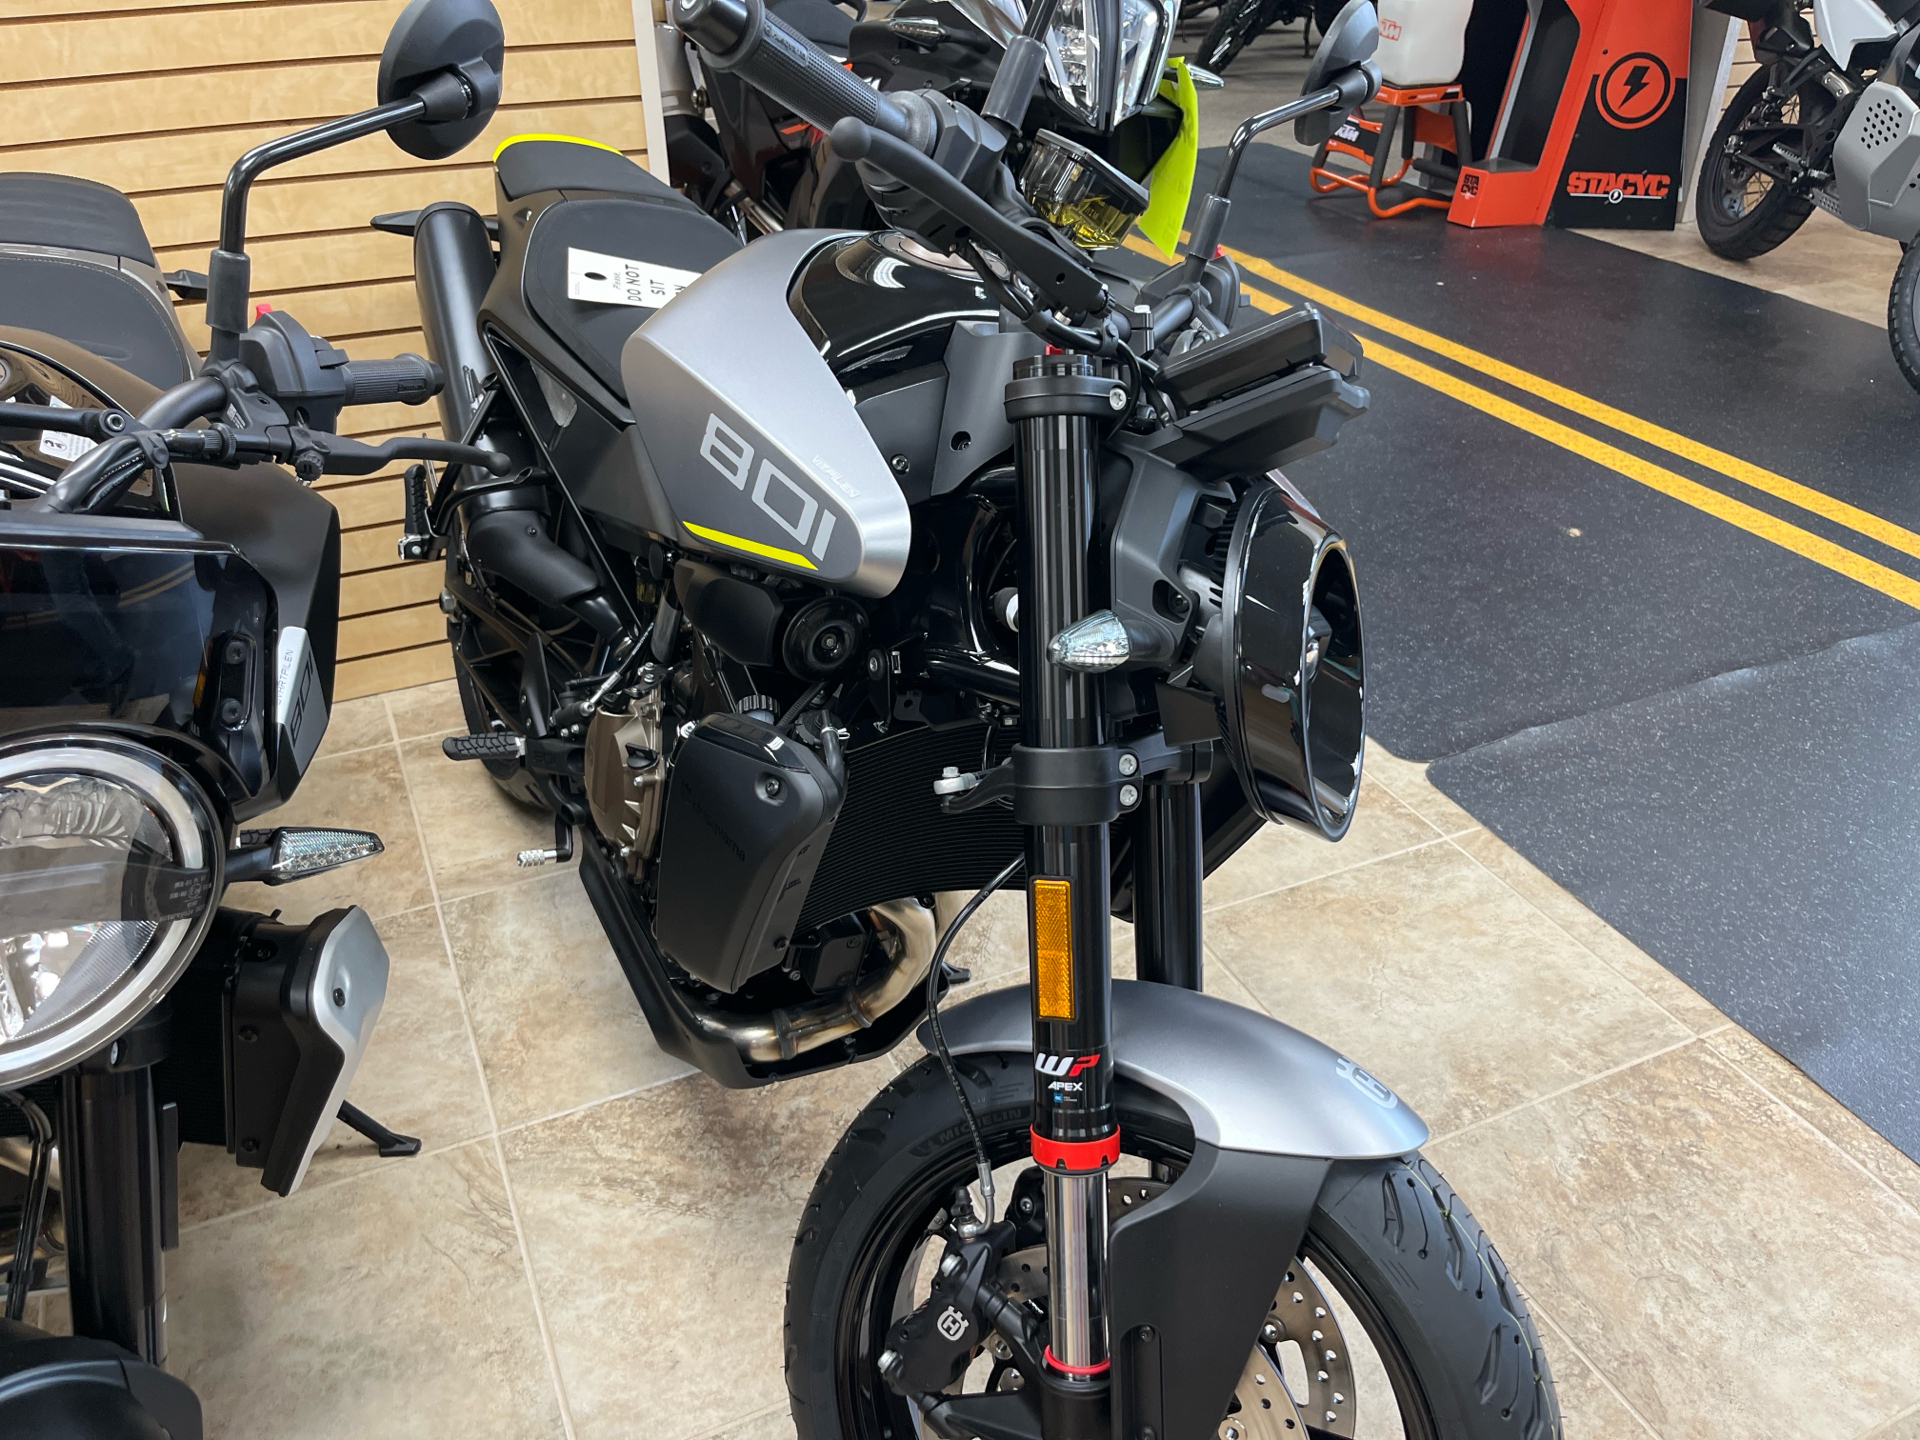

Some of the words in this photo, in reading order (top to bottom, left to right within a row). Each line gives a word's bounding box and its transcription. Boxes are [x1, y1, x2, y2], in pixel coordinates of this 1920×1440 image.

[1333, 123, 1360, 143] KTM
[1566, 170, 1671, 197] STACYC
[624, 263, 642, 287] NOT
[626, 288, 643, 302] DO
[649, 279, 666, 296] SIT
[673, 284, 687, 296] N
[700, 412, 837, 562] 801
[810, 453, 861, 499] VITPILEN
[290, 649, 314, 749] 801
[1035, 1052, 1101, 1077] WP
[1048, 1080, 1084, 1092] APEX
